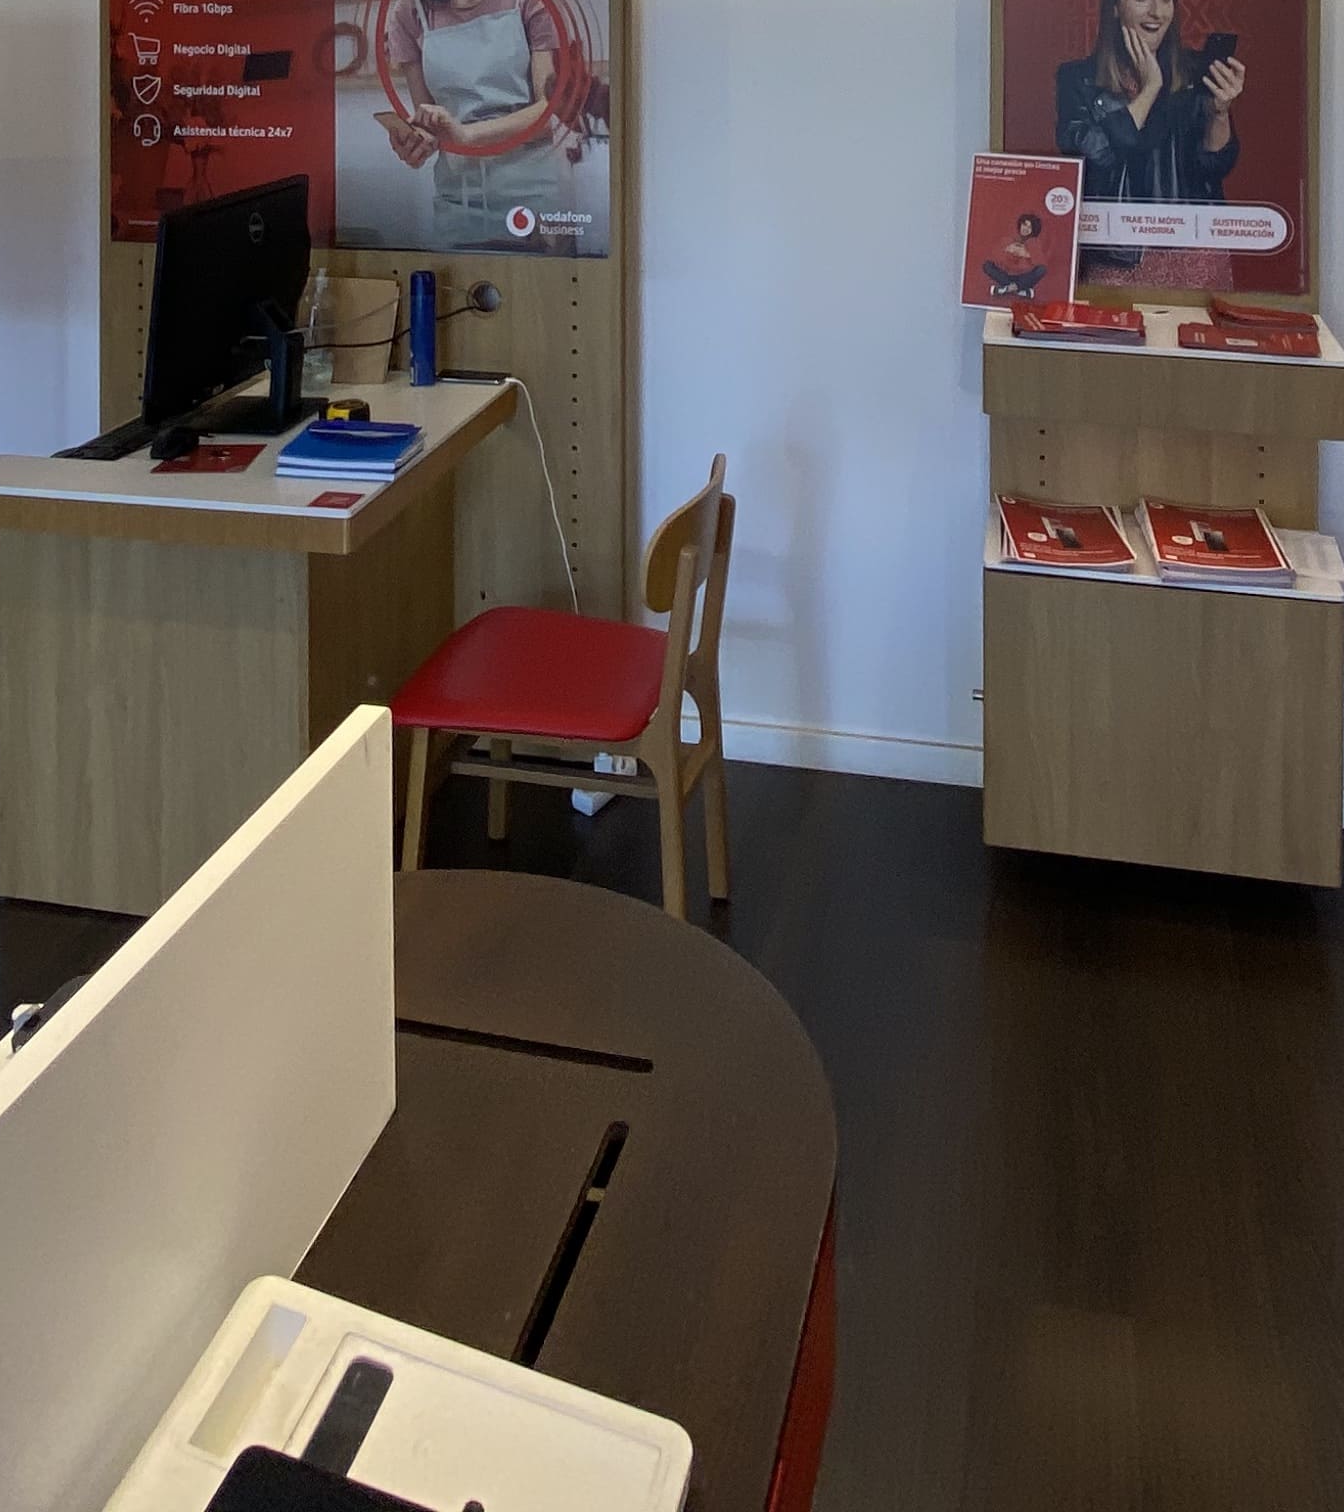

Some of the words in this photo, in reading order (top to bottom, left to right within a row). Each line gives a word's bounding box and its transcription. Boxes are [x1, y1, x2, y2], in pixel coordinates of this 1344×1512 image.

[173, 3, 199, 14] Fibra
[202, 2, 233, 16] 1Gbps
[173, 44, 215, 56] Negocio
[218, 44, 251, 57] Digital
[173, 85, 224, 97] Seguridad
[227, 85, 261, 99] Digital
[173, 125, 226, 137] Asistencia
[228, 124, 265, 138] técnica
[268, 126, 293, 138] 24x7
[539, 211, 592, 224] vodafone
[1121, 215, 1143, 224] TRAE
[1146, 216, 1157, 224] TU
[1158, 214, 1186, 225] MÓVIL
[1212, 217, 1272, 228] SUSTITUCIÓN
[539, 224, 585, 236] business
[1138, 226, 1175, 235] AHORRA
[1217, 228, 1275, 238] REPARACIÓN
